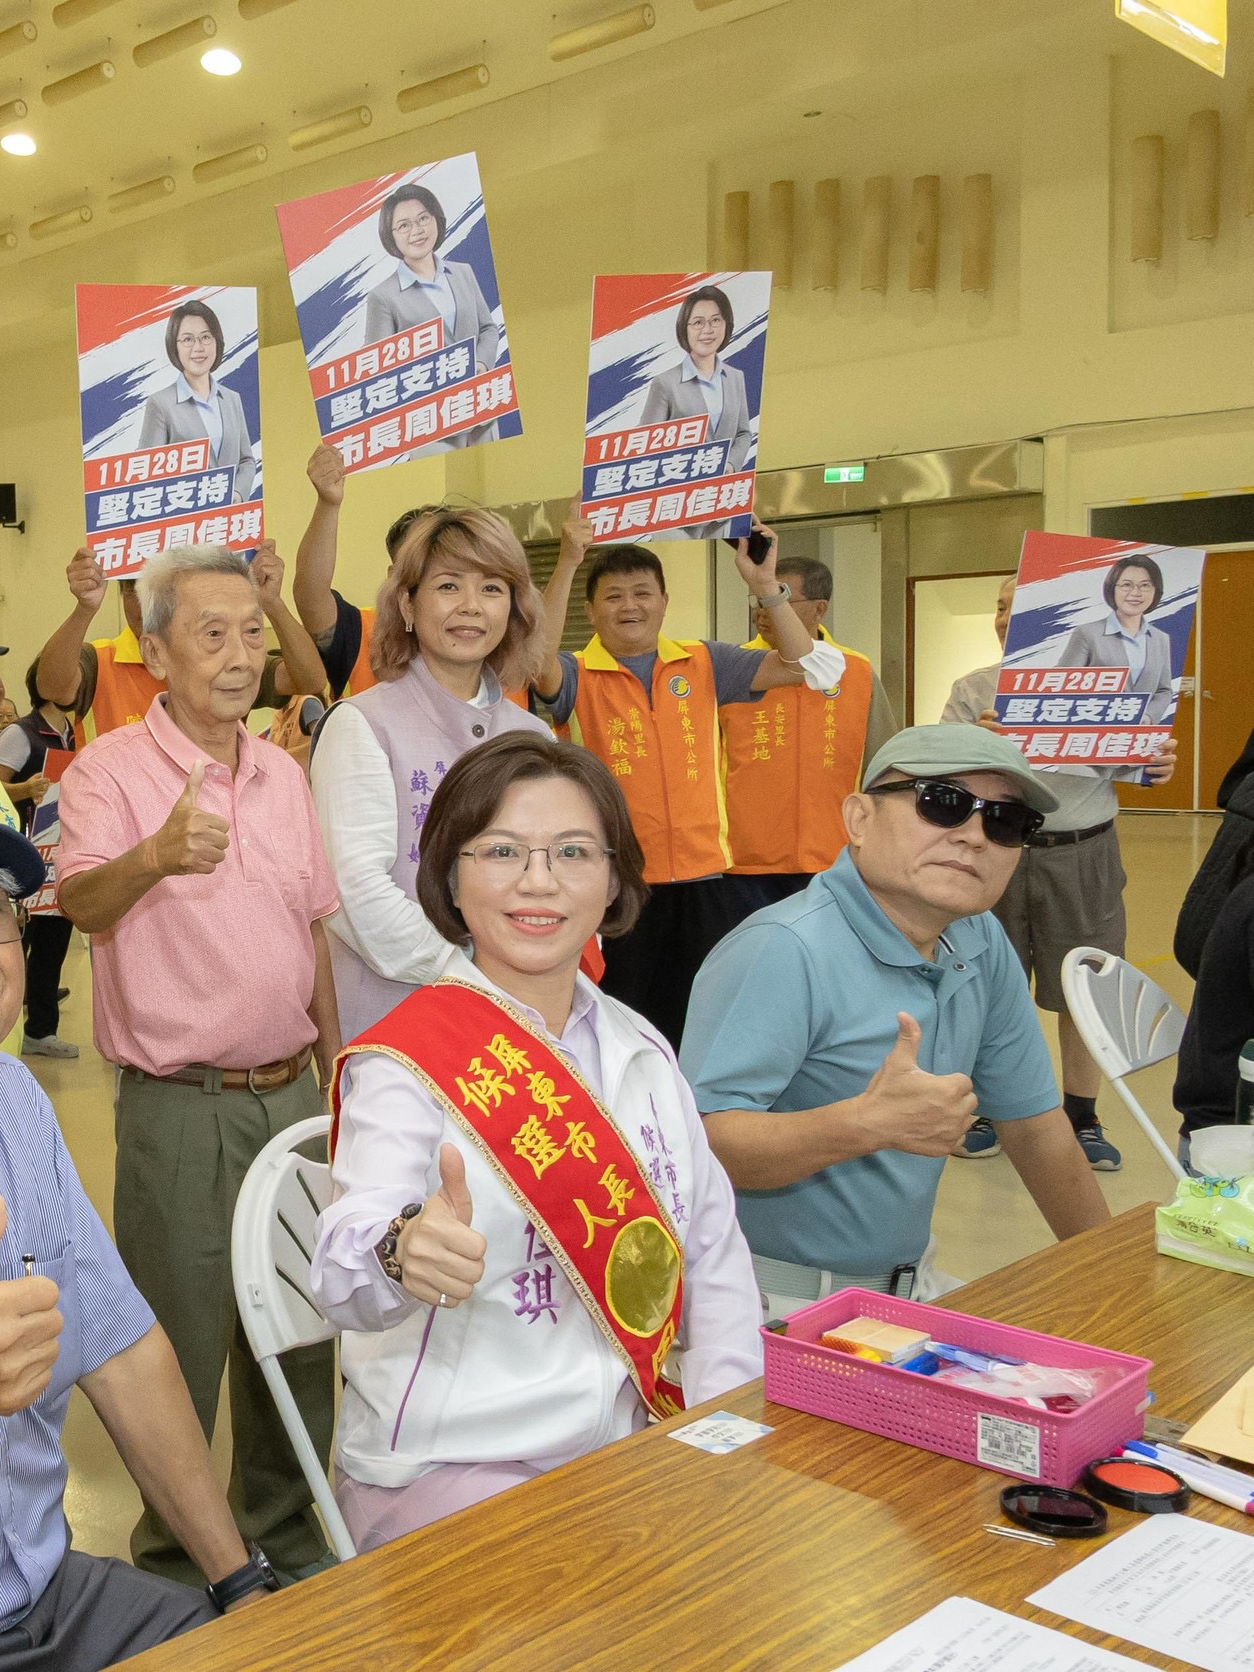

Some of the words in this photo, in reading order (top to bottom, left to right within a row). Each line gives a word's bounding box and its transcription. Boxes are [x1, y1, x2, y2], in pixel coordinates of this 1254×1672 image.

[327, 324, 439, 390] 11月28日
[330, 346, 470, 429] 堅定支持
[334, 371, 513, 466] 市長周佳琪
[599, 419, 704, 460] 11月28日
[98, 444, 206, 487] 11月28日
[591, 445, 724, 498] 堅定支持
[96, 472, 229, 527] 堅定支持
[586, 478, 753, 537] 市長周佳琪
[93, 507, 262, 571] 市長周佳琪
[1001, 697, 1143, 723] 堅定支持
[1013, 671, 1125, 693] 11月28日
[677, 700, 699, 782] 屏東市公所
[751, 710, 772, 762] 王基地
[774, 702, 786, 747] 長安里長
[822, 700, 838, 769] 屏東市公所
[454, 1057, 618, 1249] 候選人
[483, 1033, 636, 1216] 屏東市長
